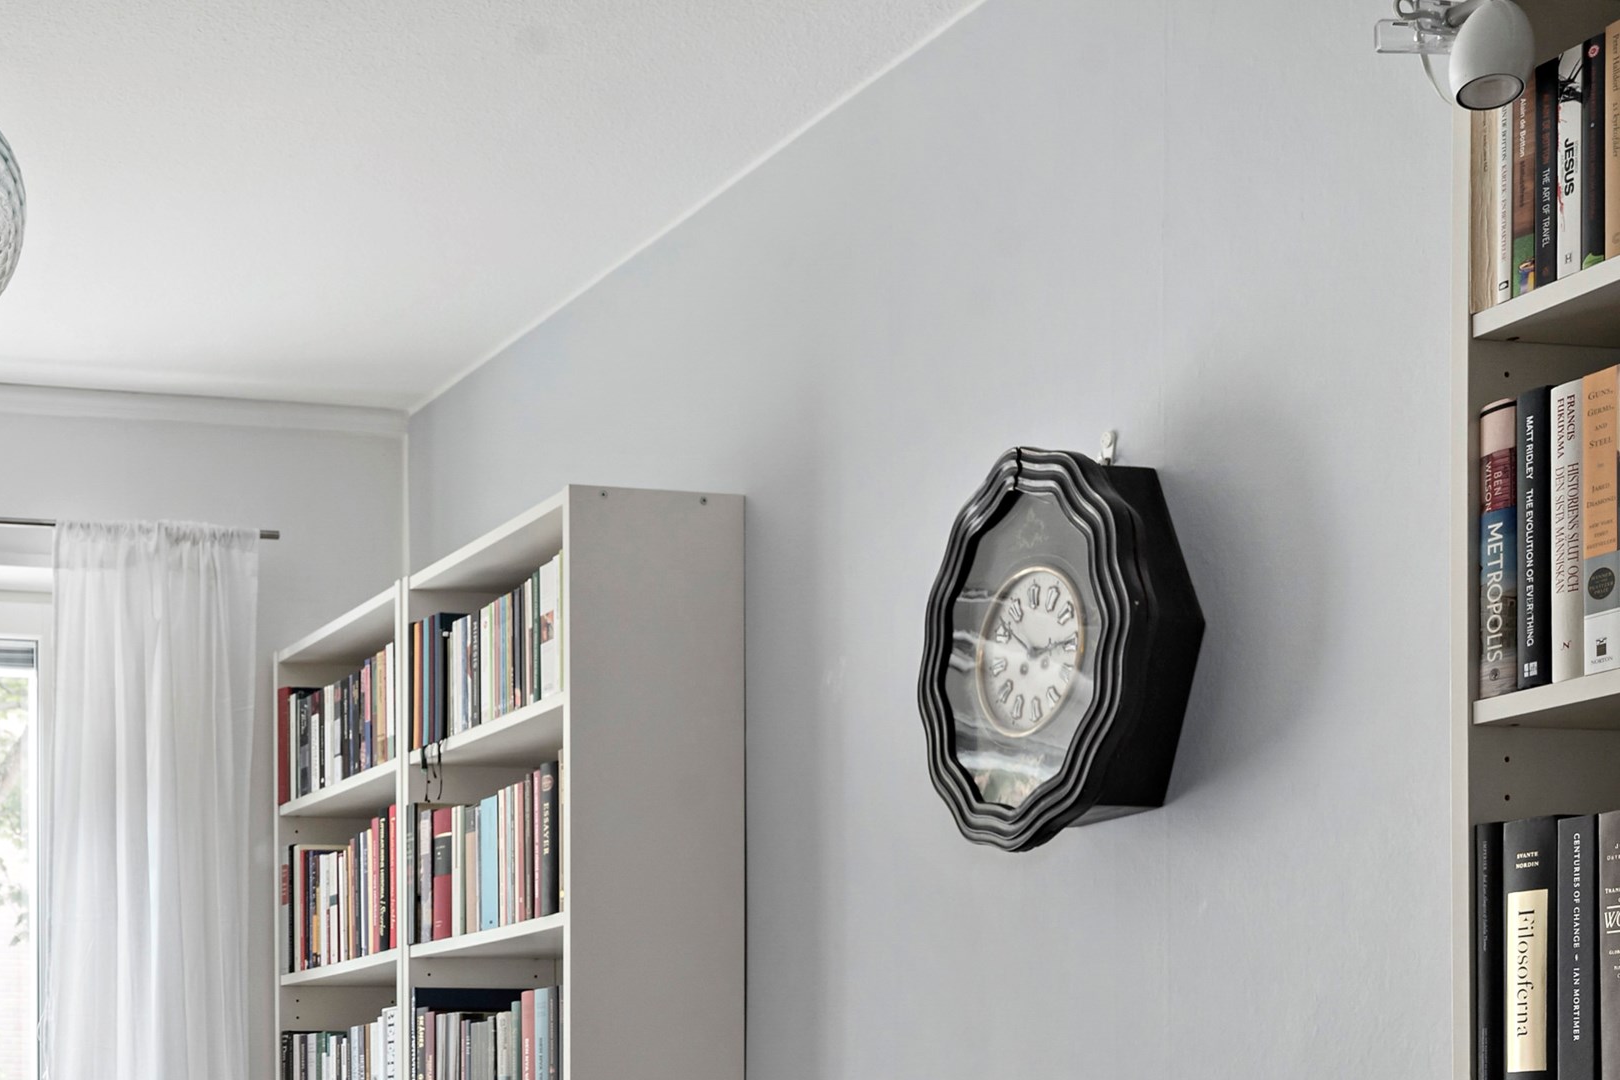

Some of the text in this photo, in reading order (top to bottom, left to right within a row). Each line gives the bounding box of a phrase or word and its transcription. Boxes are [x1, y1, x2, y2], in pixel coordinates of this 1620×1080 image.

[1542, 168, 1551, 184] THE
[1564, 138, 1574, 196] JESUS
[1542, 187, 1550, 202] ART
[1542, 204, 1550, 214] OF
[1542, 216, 1550, 248] TRAVEL
[1589, 435, 1613, 450] STEEL
[1594, 422, 1608, 432] AND
[1484, 461, 1493, 512] WILSON
[1492, 470, 1504, 496] BEN
[1555, 397, 1566, 594] FUKUYAMA DEN SISTA MÄNNISKAN
[1566, 394, 1580, 593] FRANCIS HISTORIENS SLUT OCH
[1586, 496, 1616, 509] DIAMOND
[1526, 415, 1534, 648] MATT RIDLEY THE EVOLUTION OF EVERYTHING
[1486, 522, 1504, 662] METROPOLIS
[1591, 656, 1612, 665] NORTON
[1572, 832, 1581, 1042] CENTURIES OF CHANGE IAN MORTIMER
[1516, 909, 1536, 1038] Filosoferna
